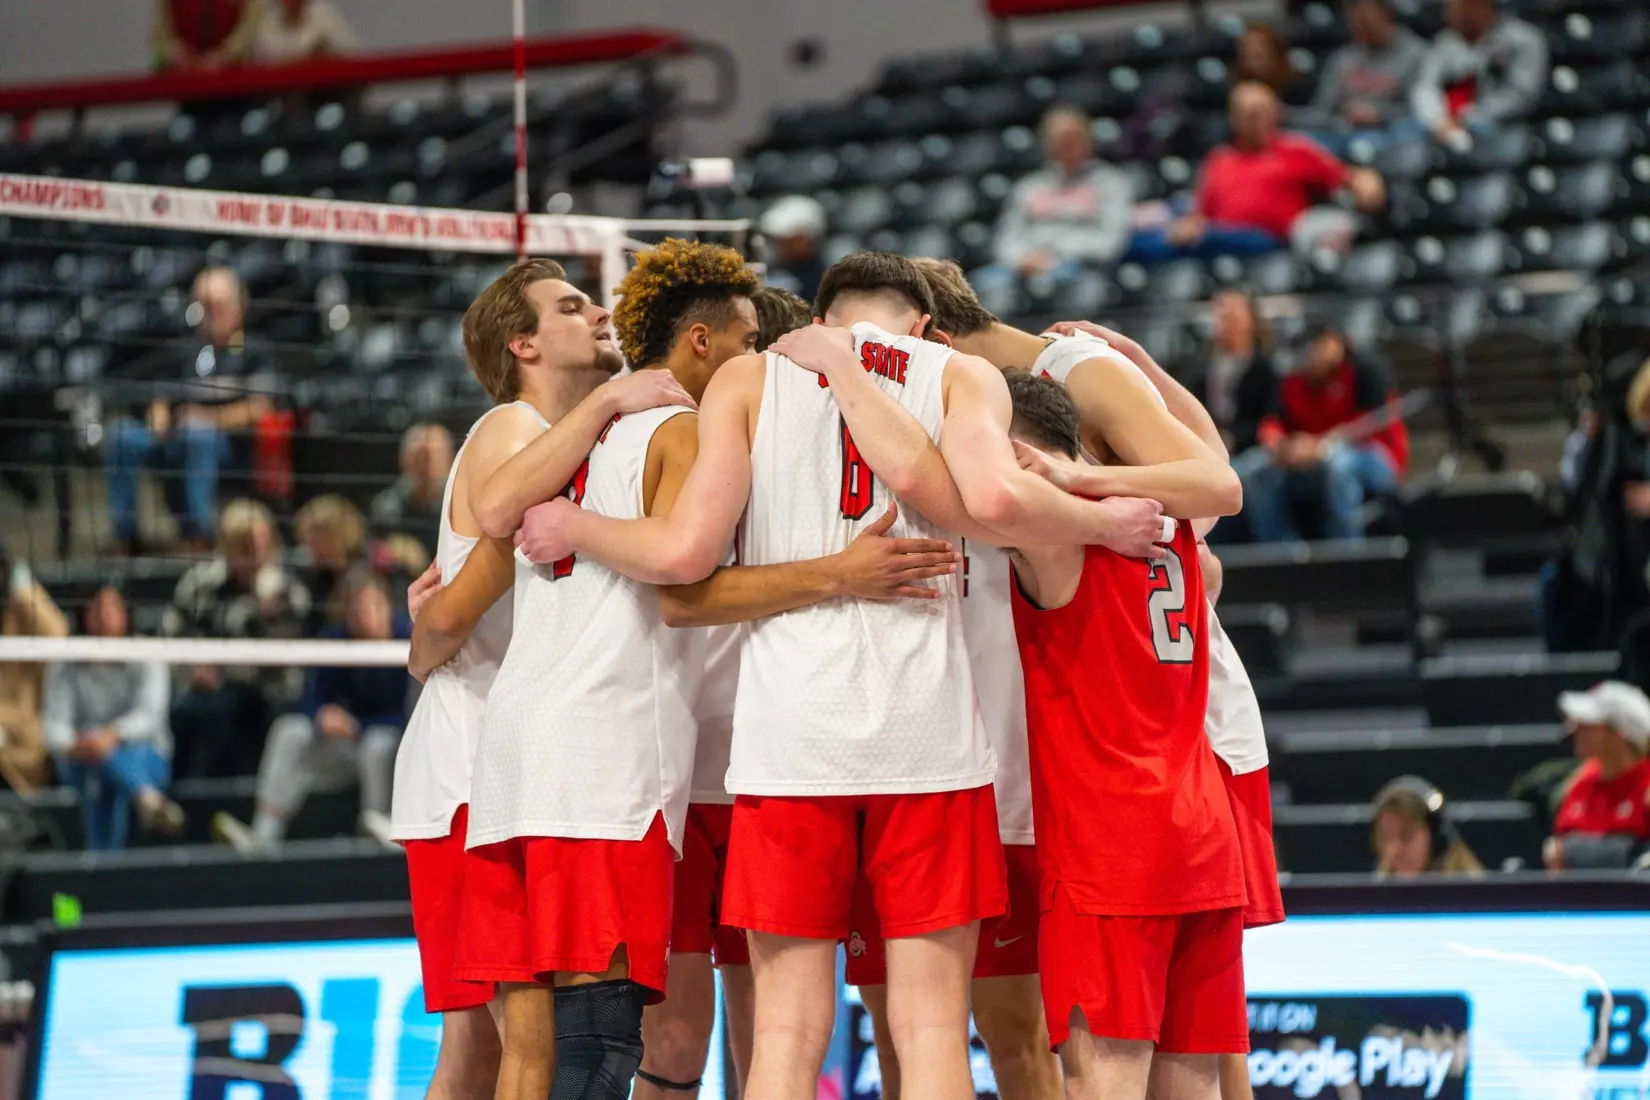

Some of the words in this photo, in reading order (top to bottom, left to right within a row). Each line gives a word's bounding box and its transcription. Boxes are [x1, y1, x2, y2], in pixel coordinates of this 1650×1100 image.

[216, 200, 261, 223] HOME
[1145, 544, 1194, 664] 2
[1248, 1035, 1357, 1098] oogle
[1359, 1034, 1454, 1099] Play
